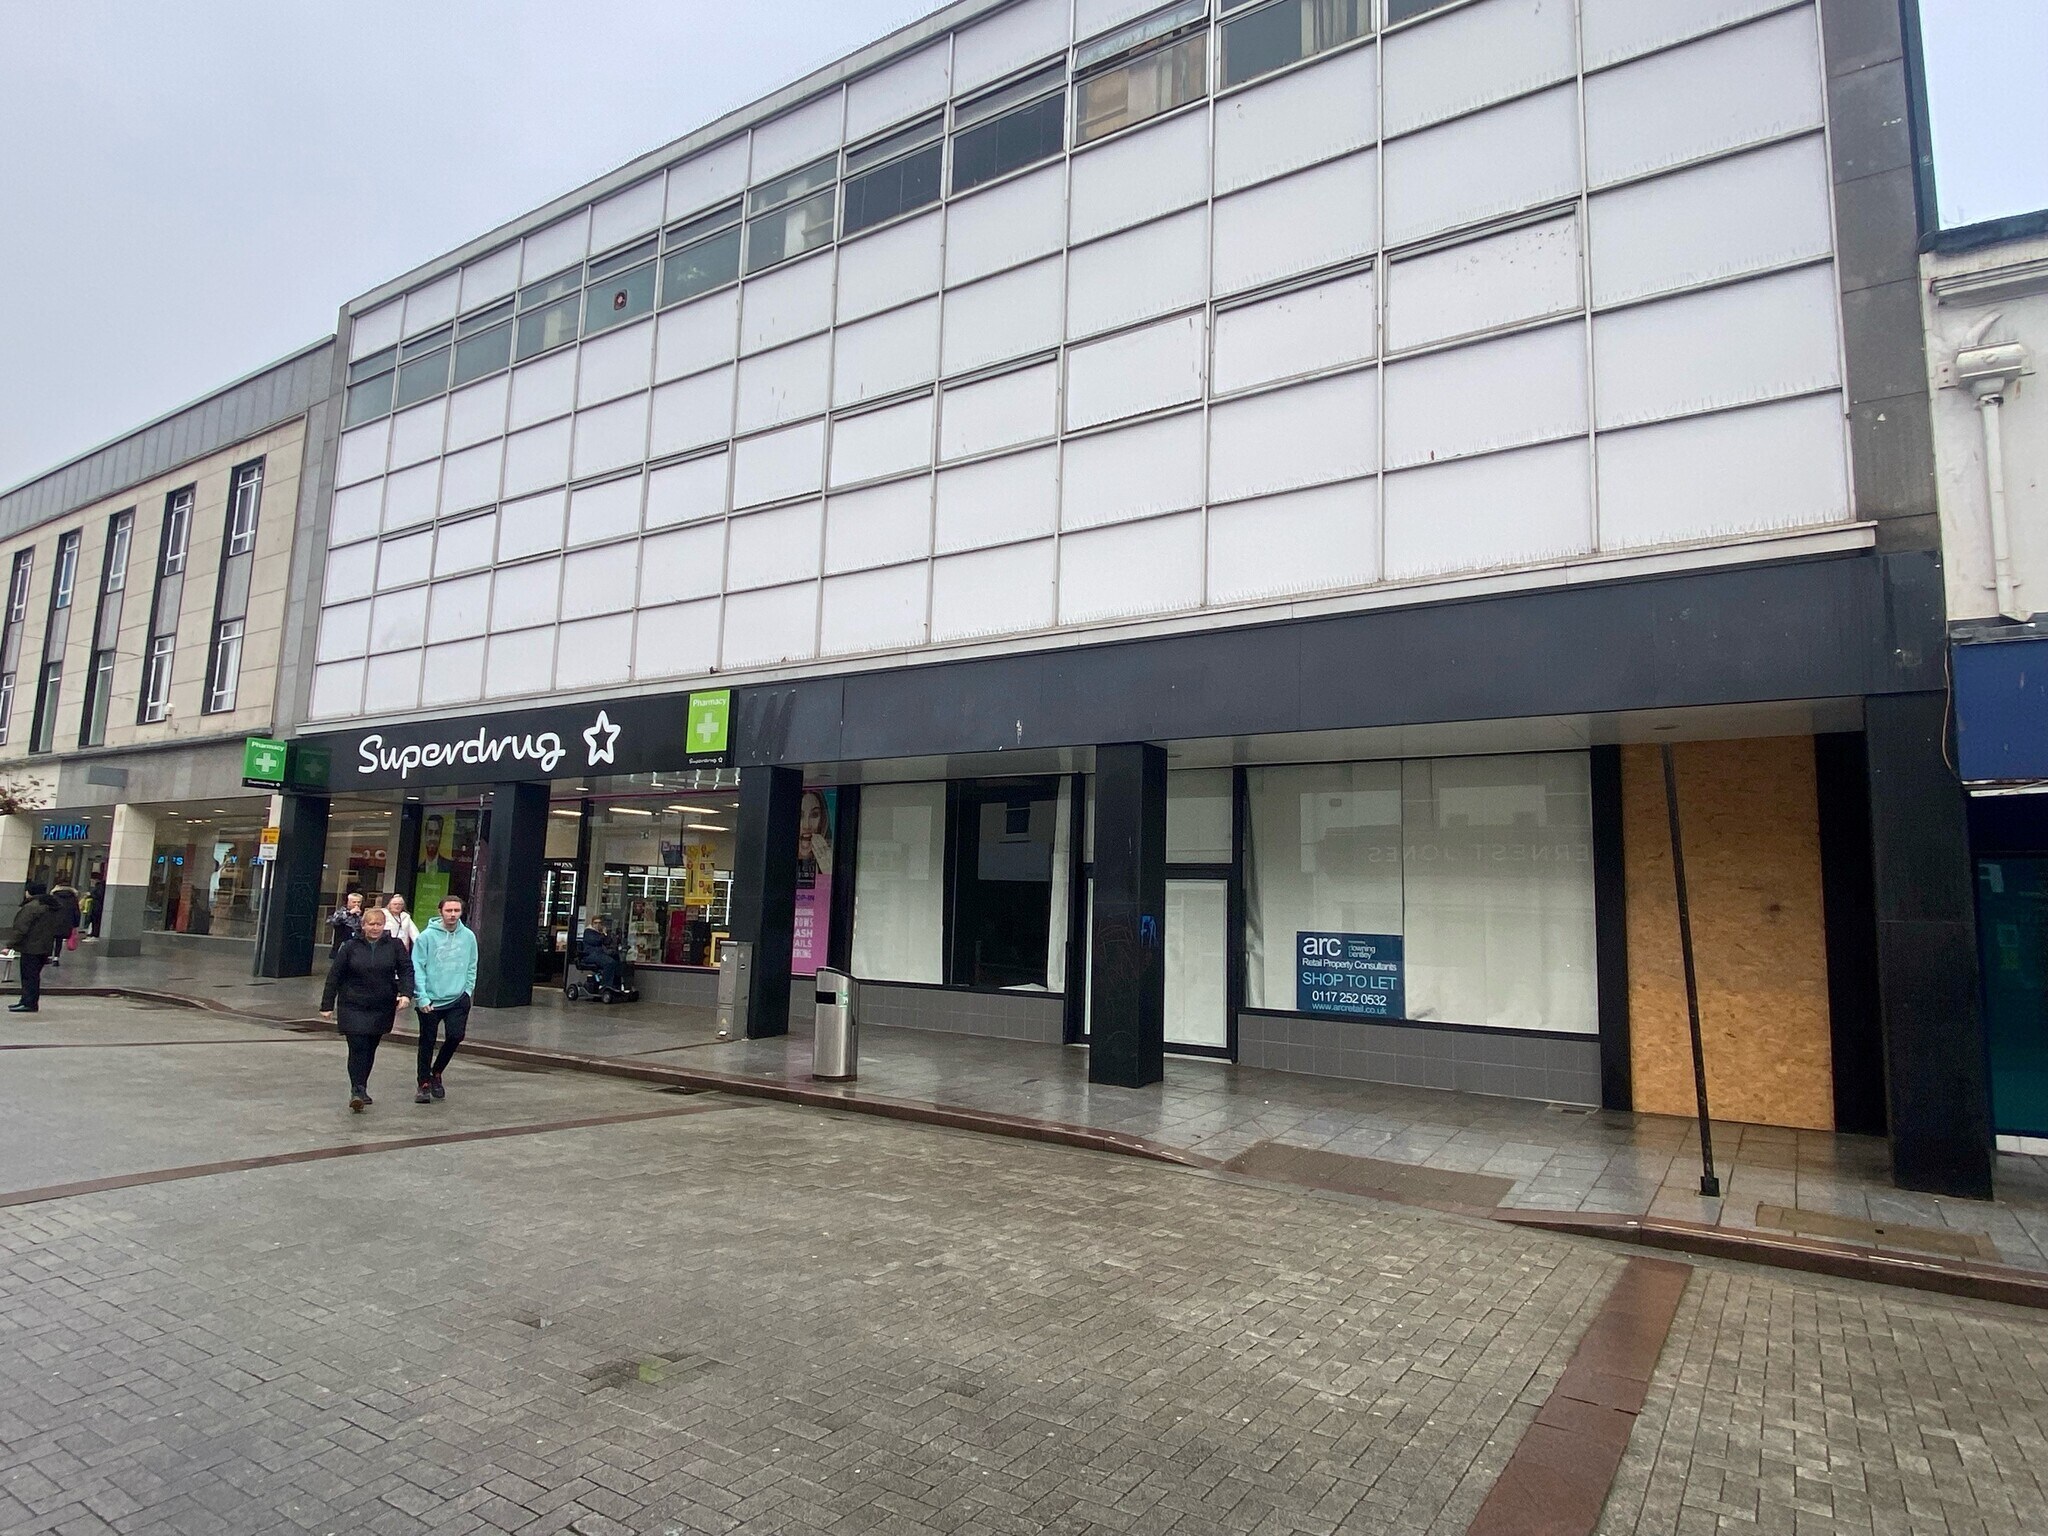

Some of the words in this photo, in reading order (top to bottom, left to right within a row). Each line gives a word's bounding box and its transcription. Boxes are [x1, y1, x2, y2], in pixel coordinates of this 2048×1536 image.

[692, 698, 727, 708] Pharmacy
[251, 741, 285, 752] Pharmacy
[358, 726, 566, 779] Superdrug
[43, 824, 89, 841] PRIMARK
[794, 917, 814, 927] ROWS
[794, 929, 813, 938] ASH
[793, 939, 813, 948] AILS
[1302, 937, 1341, 956] arc
[1302, 958, 1322, 967] Retail
[1323, 959, 1353, 971] Property
[1354, 961, 1397, 971] Consultants
[1302, 972, 1344, 986] SHOP
[1346, 975, 1367, 988] TO
[1370, 976, 1397, 990] LET
[1312, 990, 1337, 1002] 0117
[1339, 993, 1359, 1004] 252
[1361, 994, 1387, 1006] 0532
[1311, 1003, 1387, 1014] www.arcretail.co.uk
